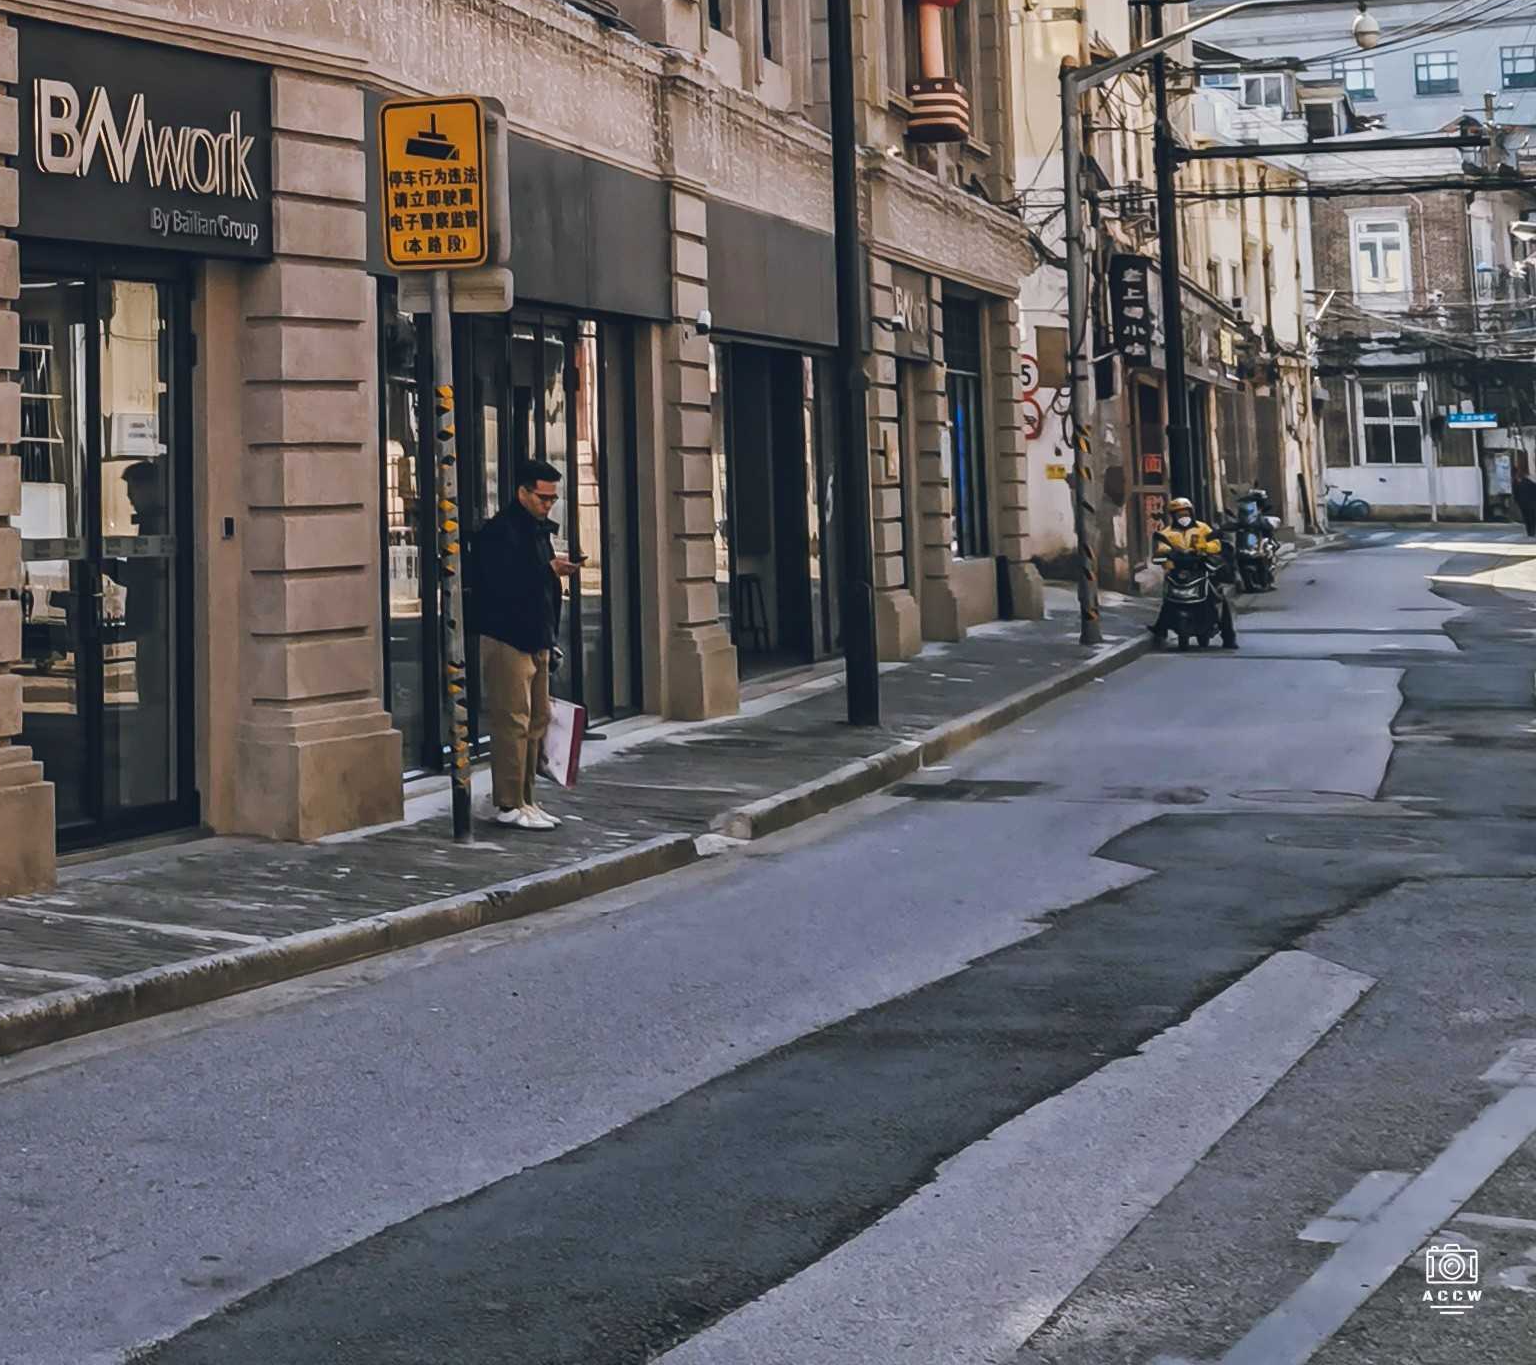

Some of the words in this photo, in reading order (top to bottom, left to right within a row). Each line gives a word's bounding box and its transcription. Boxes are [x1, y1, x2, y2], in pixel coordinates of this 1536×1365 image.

[389, 166, 478, 188] 停车行为违法
[394, 188, 473, 209] 请立即驶离
[151, 207, 170, 237] By
[173, 209, 218, 237] Bailian
[218, 215, 259, 246] Group
